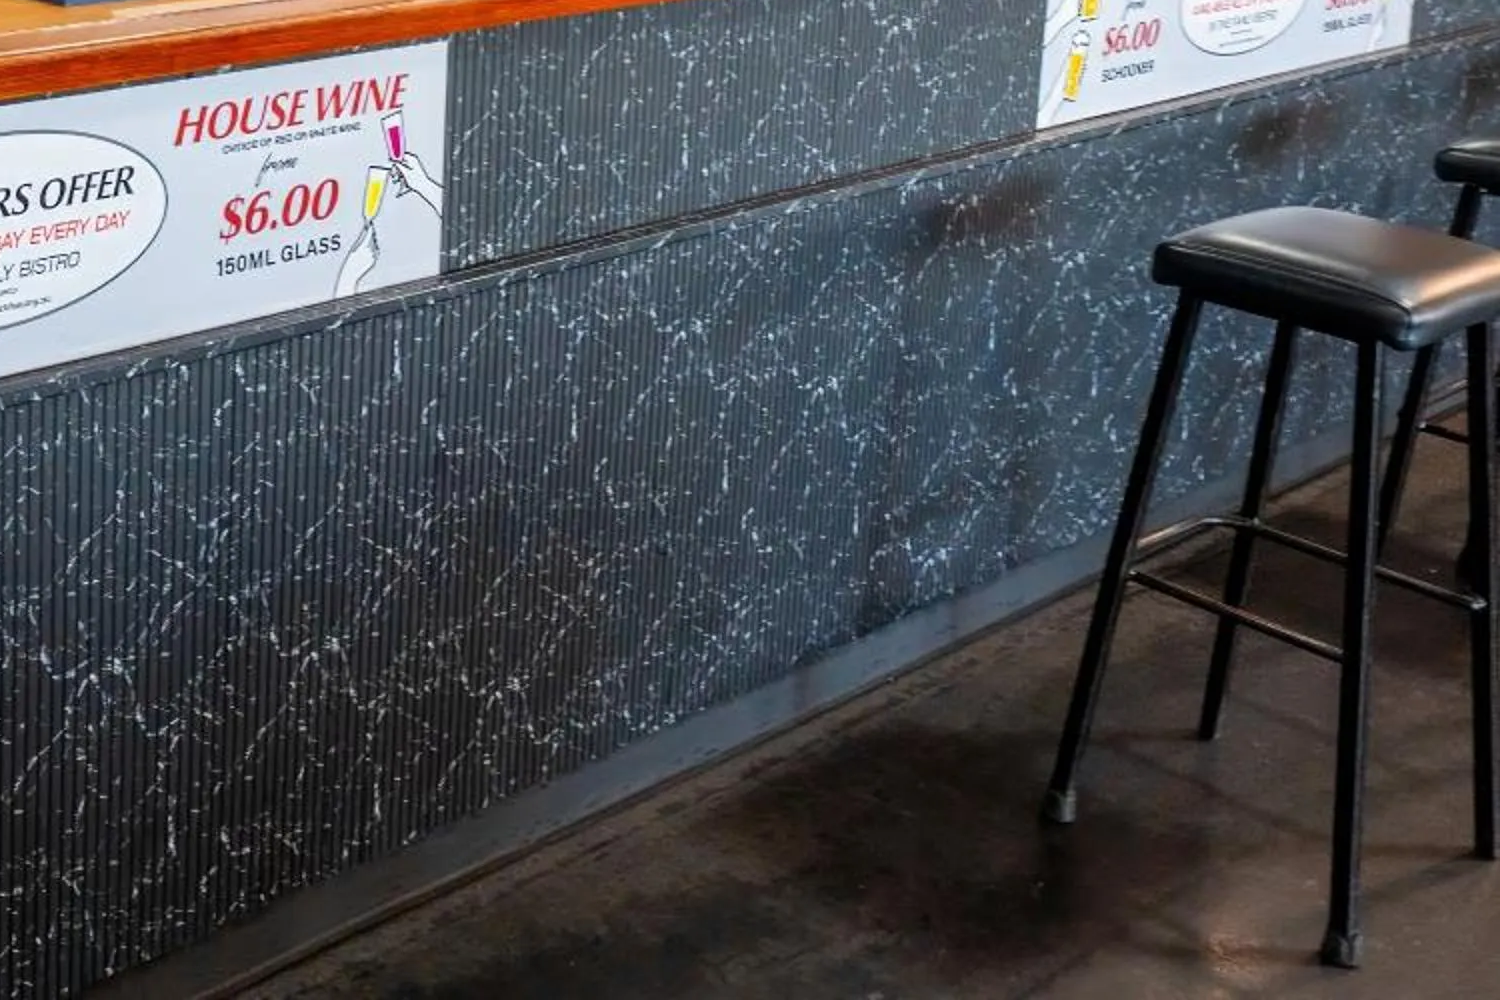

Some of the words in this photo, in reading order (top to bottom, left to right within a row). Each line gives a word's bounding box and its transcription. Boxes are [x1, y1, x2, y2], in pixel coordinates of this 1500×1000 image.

[1102, 18, 1161, 56] $6.00
[173, 88, 309, 147] HOUSE
[314, 74, 411, 122] WINE
[39, 165, 136, 210] OFFER
[255, 152, 300, 189] from
[29, 217, 91, 246] EVERY
[94, 209, 133, 234] DAY
[219, 178, 340, 245] $6.00
[19, 250, 82, 278] BISTRO
[215, 250, 276, 278] 150ML
[280, 234, 342, 264] GLASS
